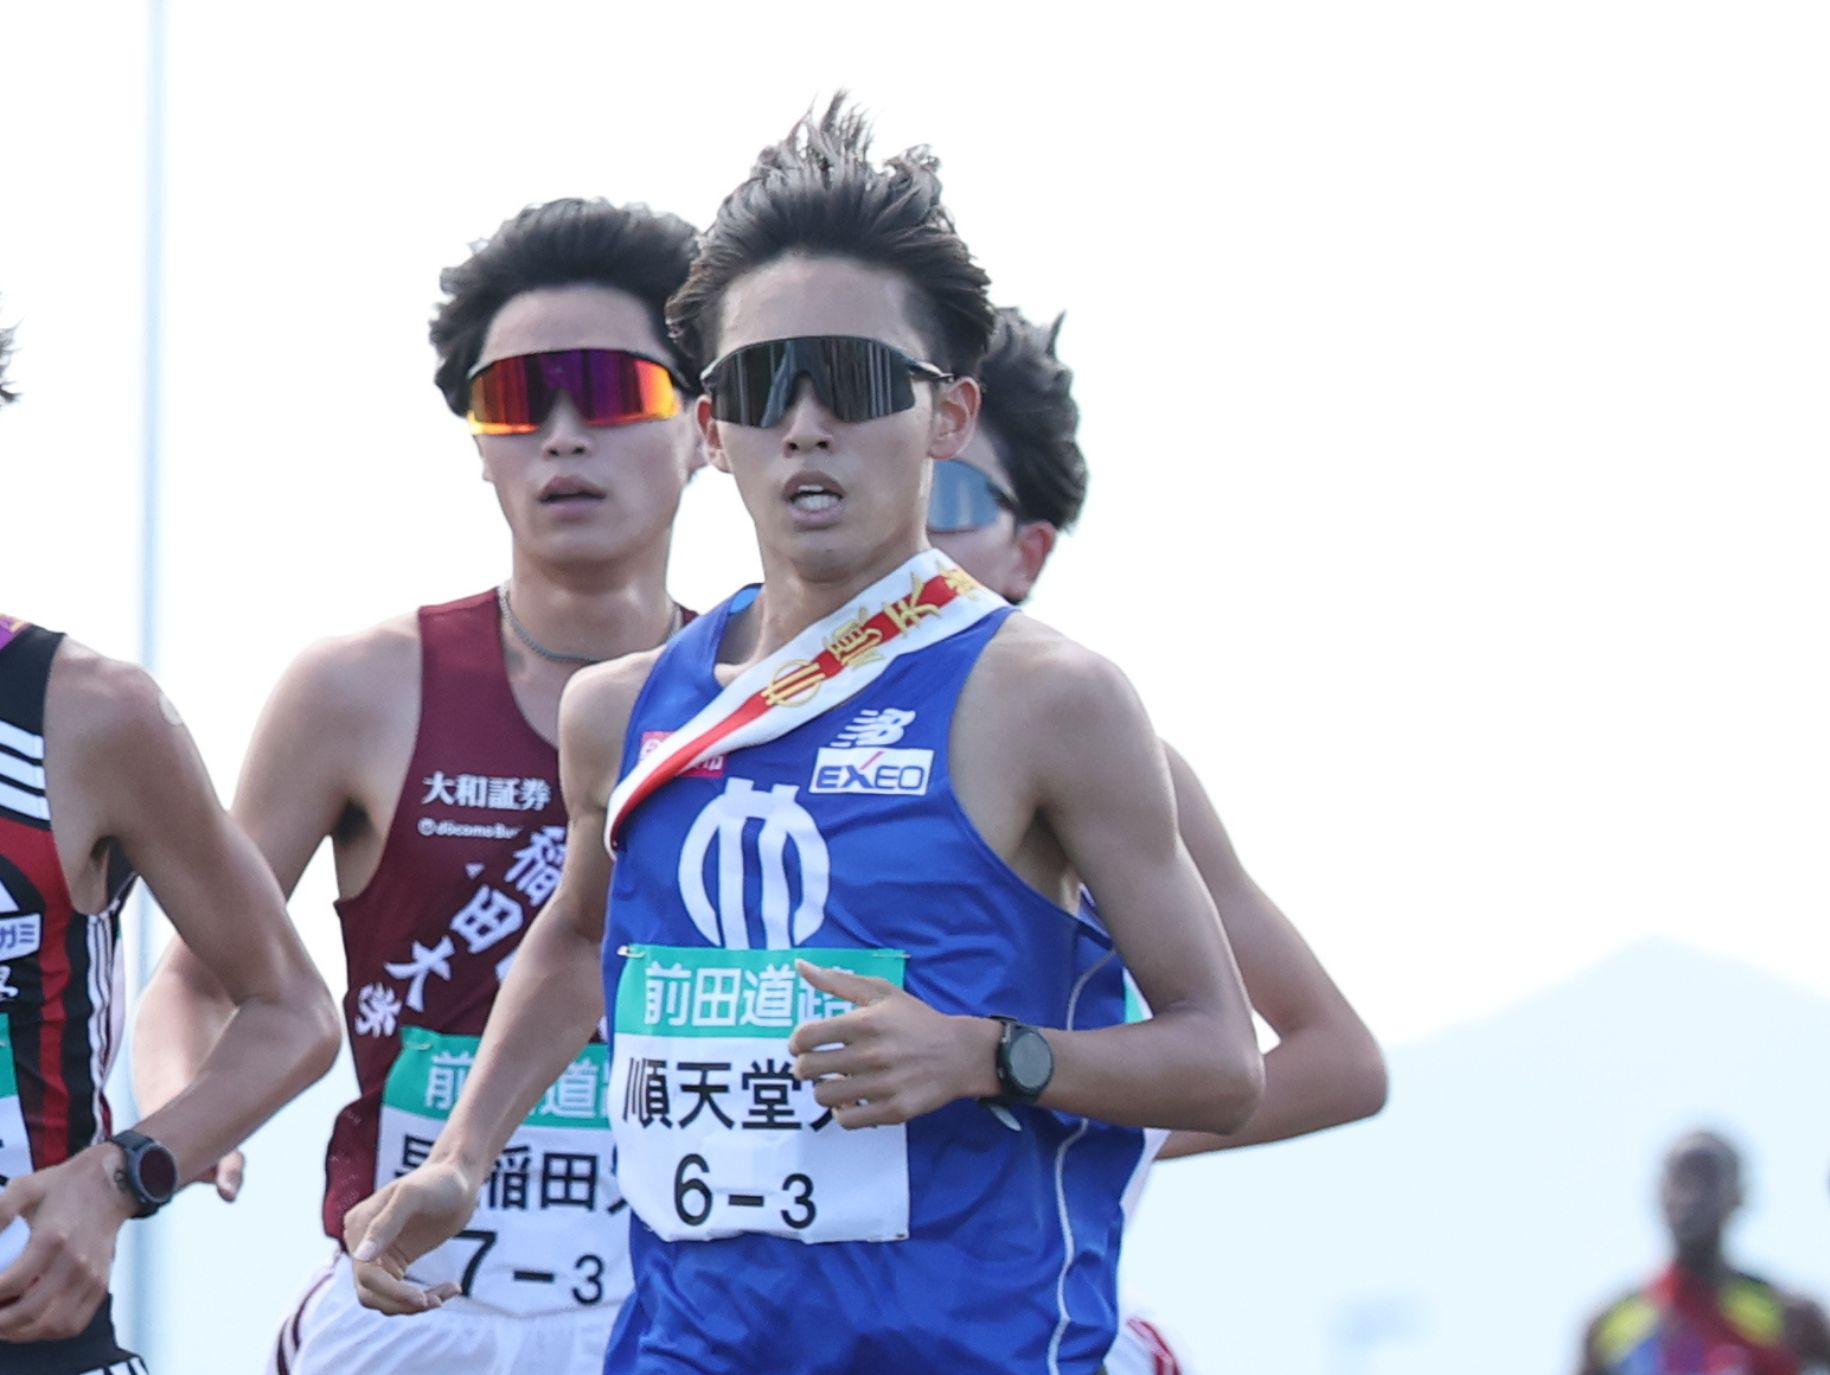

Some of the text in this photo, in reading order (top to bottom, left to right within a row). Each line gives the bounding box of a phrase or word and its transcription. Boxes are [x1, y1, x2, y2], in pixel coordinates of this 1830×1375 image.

[421, 770, 552, 812] 大和証券
[816, 750, 926, 791] EXEO
[424, 1050, 608, 1118] 前道
[622, 1058, 878, 1132] 順天堂
[395, 1134, 628, 1214] 稲田
[674, 1153, 817, 1230] 6-3
[452, 1229, 605, 1306] 7-3
